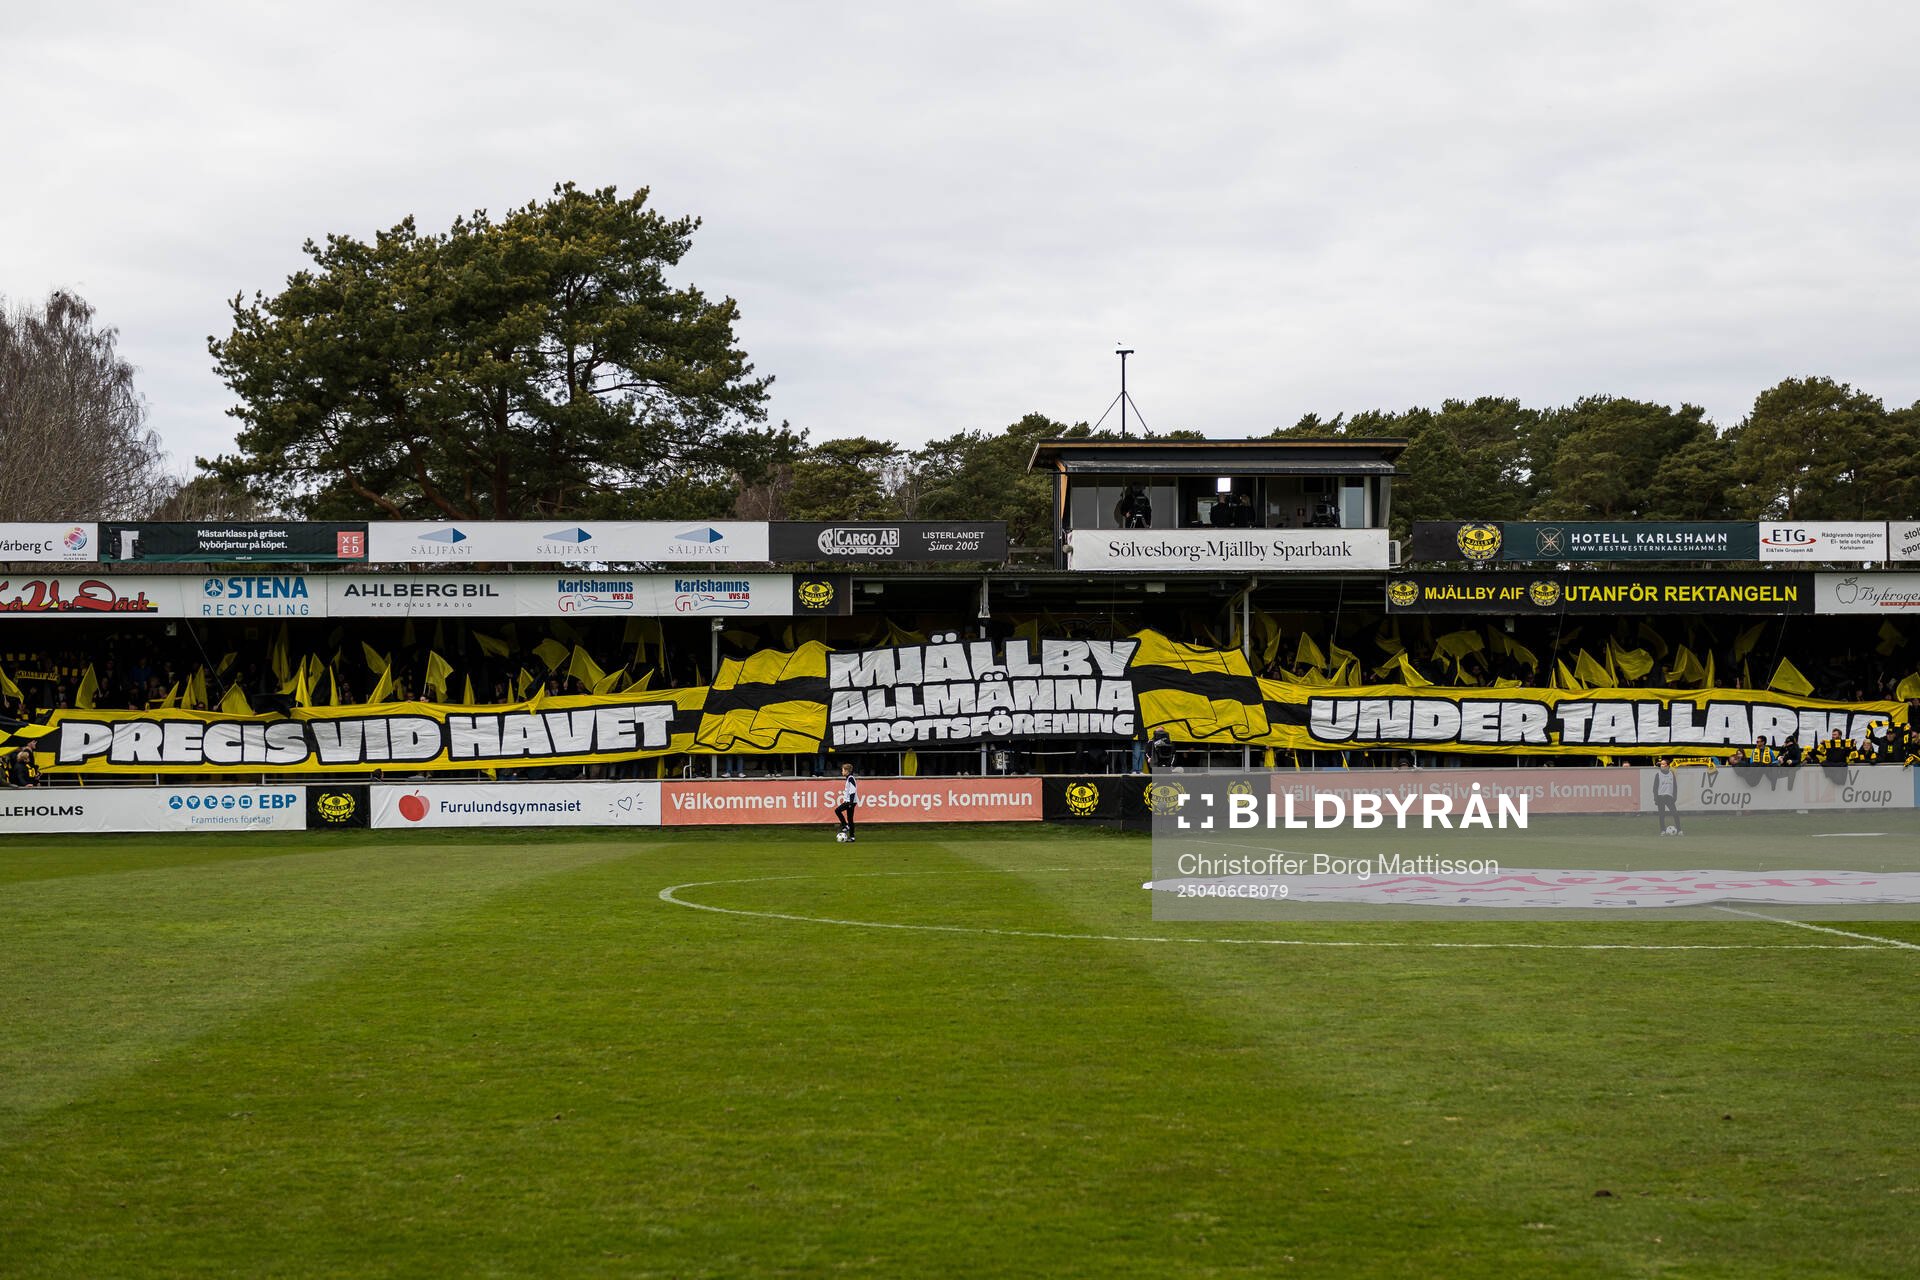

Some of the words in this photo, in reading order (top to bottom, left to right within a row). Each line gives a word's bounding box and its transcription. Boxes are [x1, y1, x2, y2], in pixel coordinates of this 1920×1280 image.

[197, 530, 247, 538] Mästarklass
[247, 530, 258, 539] på
[259, 530, 289, 539] gräset.
[836, 531, 874, 546] CARGO
[880, 530, 898, 545] AB
[922, 531, 985, 539] LISTERLANDET
[1571, 533, 1629, 544] HOTELL
[1636, 533, 1728, 543] KARLSHAMN
[1772, 529, 1806, 542] ETG
[44, 541, 53, 551] C
[199, 541, 248, 550] Nybörjartur
[249, 541, 260, 550] på
[260, 541, 288, 550] köpet.
[411, 545, 473, 555] SÄLJFAST
[536, 545, 598, 555] SÄLJFAST
[668, 545, 730, 554] SÄLJFAST
[928, 541, 953, 551] Since
[955, 541, 980, 551] 2005
[1109, 540, 1268, 562] Sölvesborg-Mjällby
[1273, 540, 1352, 561] Sparbank
[227, 576, 309, 598] STENA
[344, 583, 458, 597] AHLBERG
[463, 583, 499, 597] BIL
[558, 579, 634, 593] Karlshamns
[674, 579, 750, 593] Karlshamns
[1425, 584, 1496, 600] MJÄLLBY
[1499, 586, 1525, 600] AIF
[1564, 583, 1659, 602] UTANFÖR
[1665, 585, 1797, 602] REKTANGELN
[1860, 586, 1920, 609] Bykroge
[203, 604, 309, 616] RECYCLING
[829, 632, 1138, 689] MJÄLLBY
[830, 672, 1135, 723] ALLMÄNNA
[832, 709, 1134, 746] IDROTTSFÖRENING
[1310, 699, 1548, 743] UNDER
[59, 720, 308, 763] PRECIS
[311, 717, 442, 763] VID
[449, 704, 675, 758] HAVET
[1700, 771, 1719, 788] IV
[1848, 769, 1860, 786] V
[1429, 780, 1544, 801] Sölvsborgs
[1551, 780, 1632, 799] kommun
[1701, 789, 1751, 808] Group
[1842, 786, 1892, 806] Group
[259, 794, 297, 809] EBP
[440, 799, 581, 816] Furulundsgymnasiet
[671, 791, 787, 810] Välkommen
[792, 790, 818, 809] till
[823, 789, 943, 811] Sövesborgs
[947, 788, 1032, 807] kommun
[191, 815, 239, 824] Framtidens
[240, 815, 274, 825] företag!
